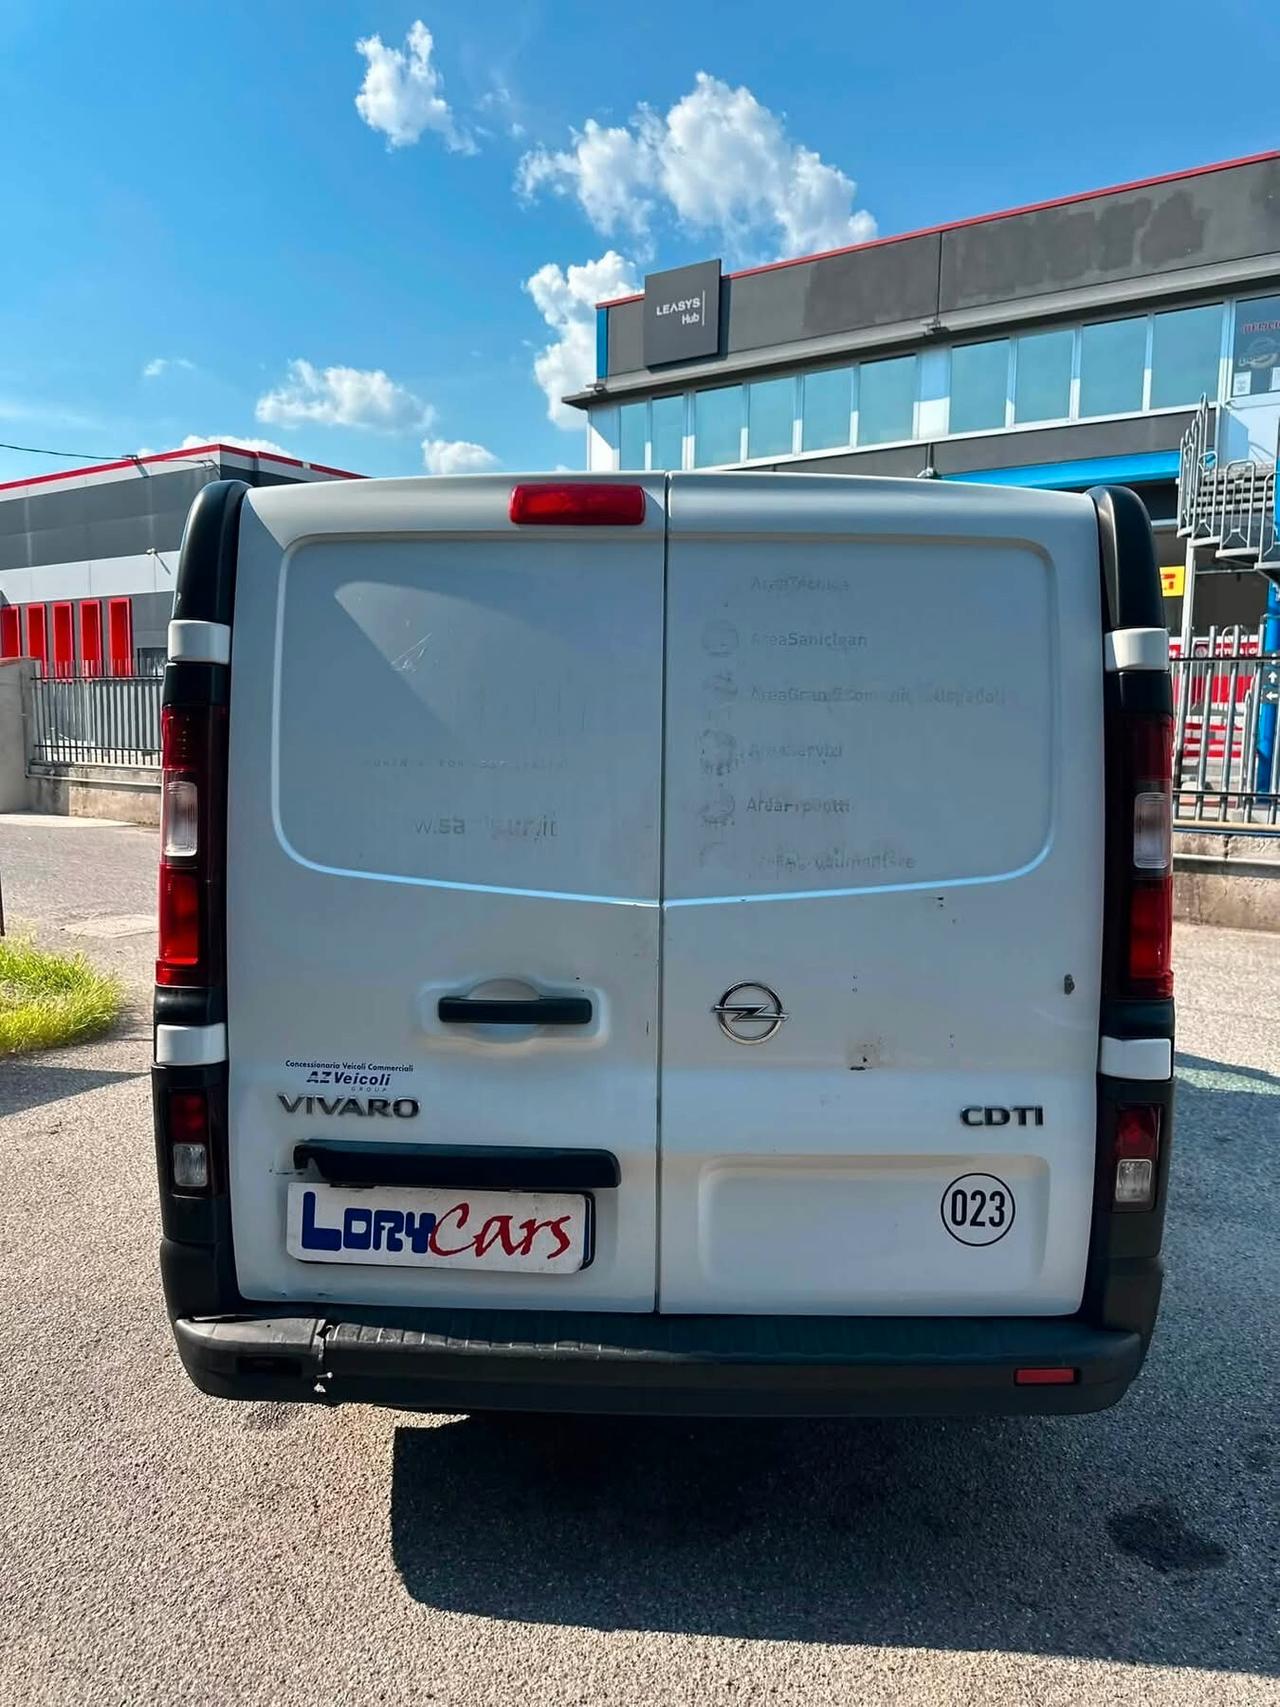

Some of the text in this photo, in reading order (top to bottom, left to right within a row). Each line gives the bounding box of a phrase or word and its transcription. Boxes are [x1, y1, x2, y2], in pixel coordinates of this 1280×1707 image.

[656, 298, 701, 316] LEASYS
[681, 312, 700, 325] Hub
[342, 1062, 366, 1071] Veicoli
[367, 1064, 414, 1072] Commerciali
[277, 1094, 420, 1119] VIVARO
[960, 1106, 1044, 1127] CDTI
[951, 1189, 1006, 1227] 023
